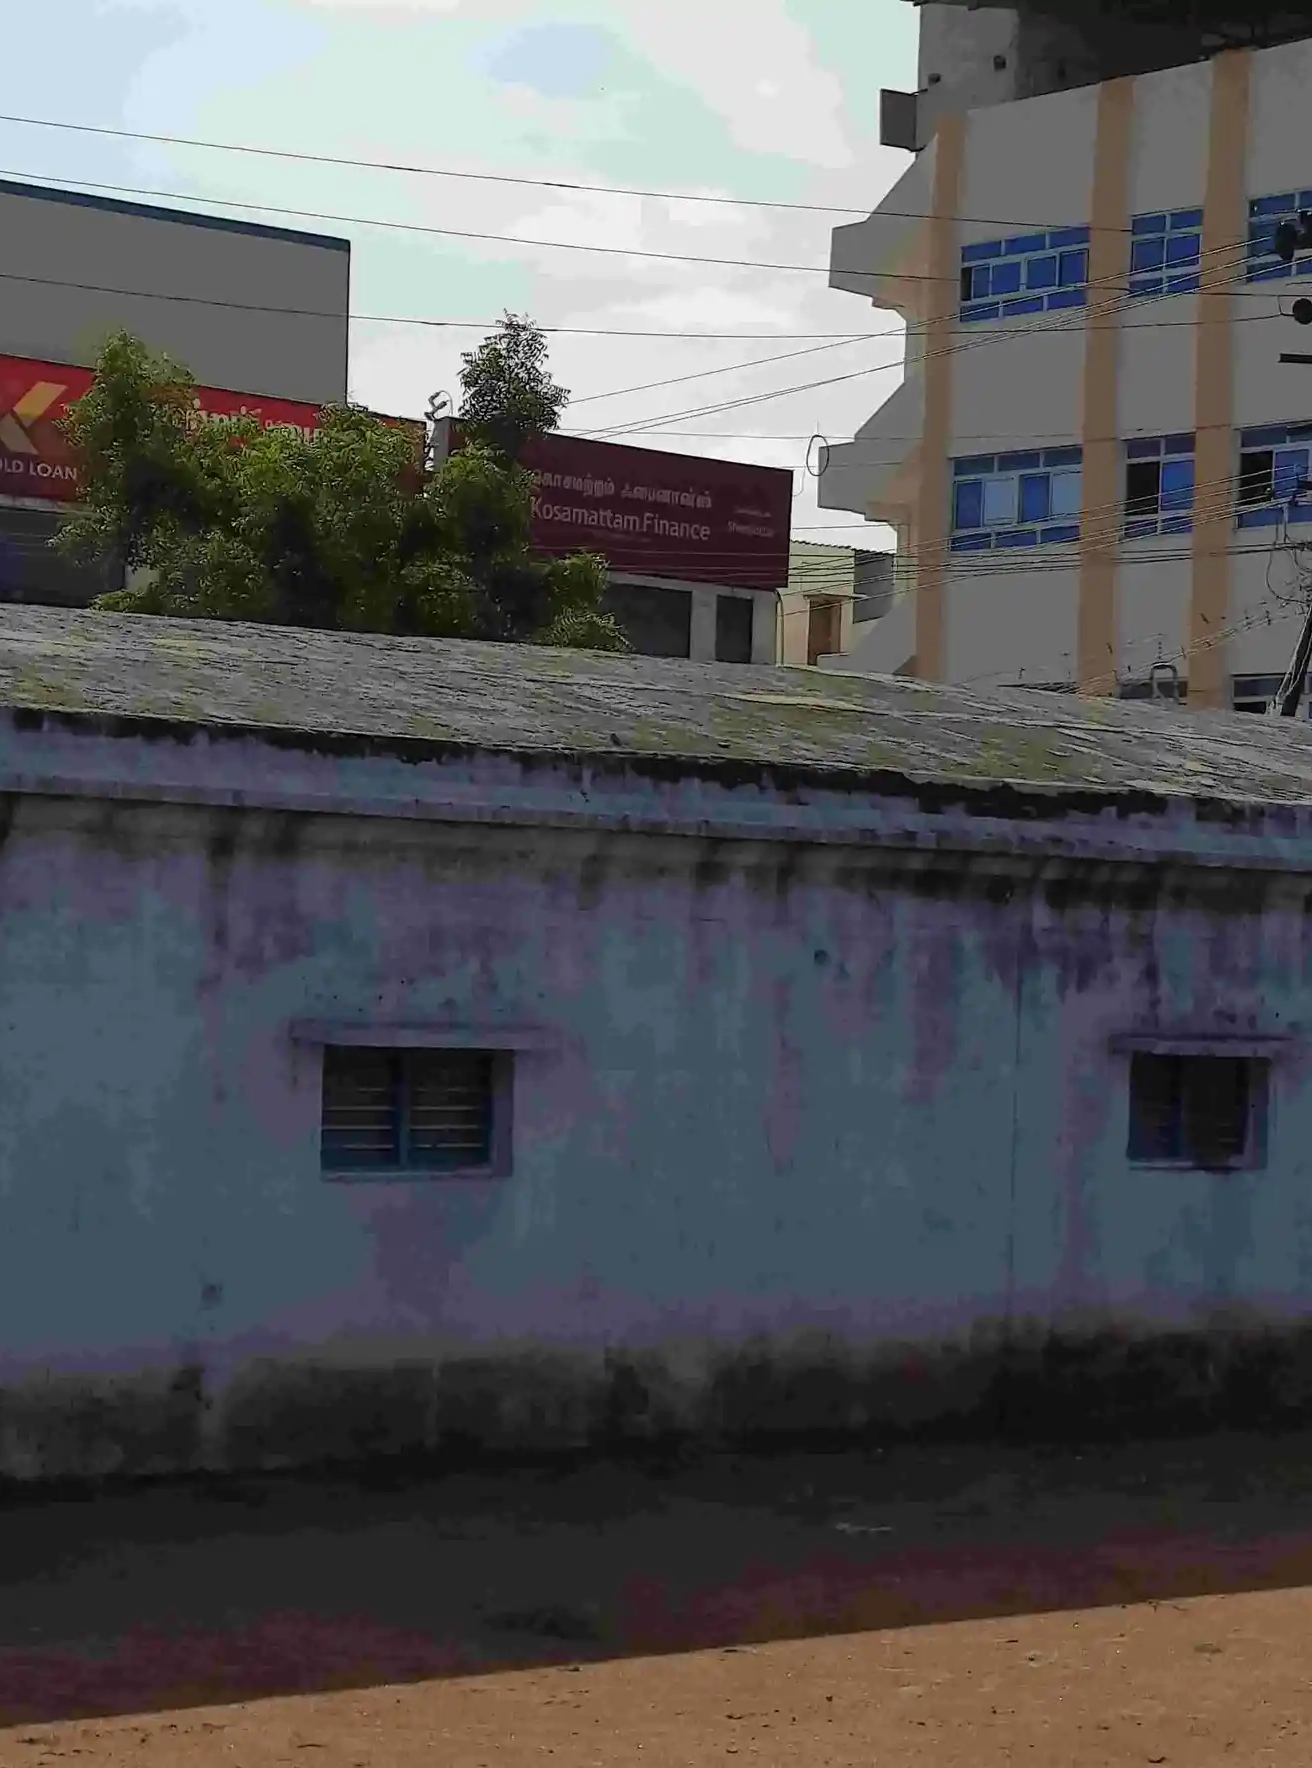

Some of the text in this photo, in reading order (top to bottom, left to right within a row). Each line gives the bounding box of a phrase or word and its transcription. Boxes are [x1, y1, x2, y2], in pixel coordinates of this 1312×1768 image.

[29, 460, 78, 481] LOAN
[530, 496, 639, 533] Kosamattam
[643, 512, 711, 541] Finance
